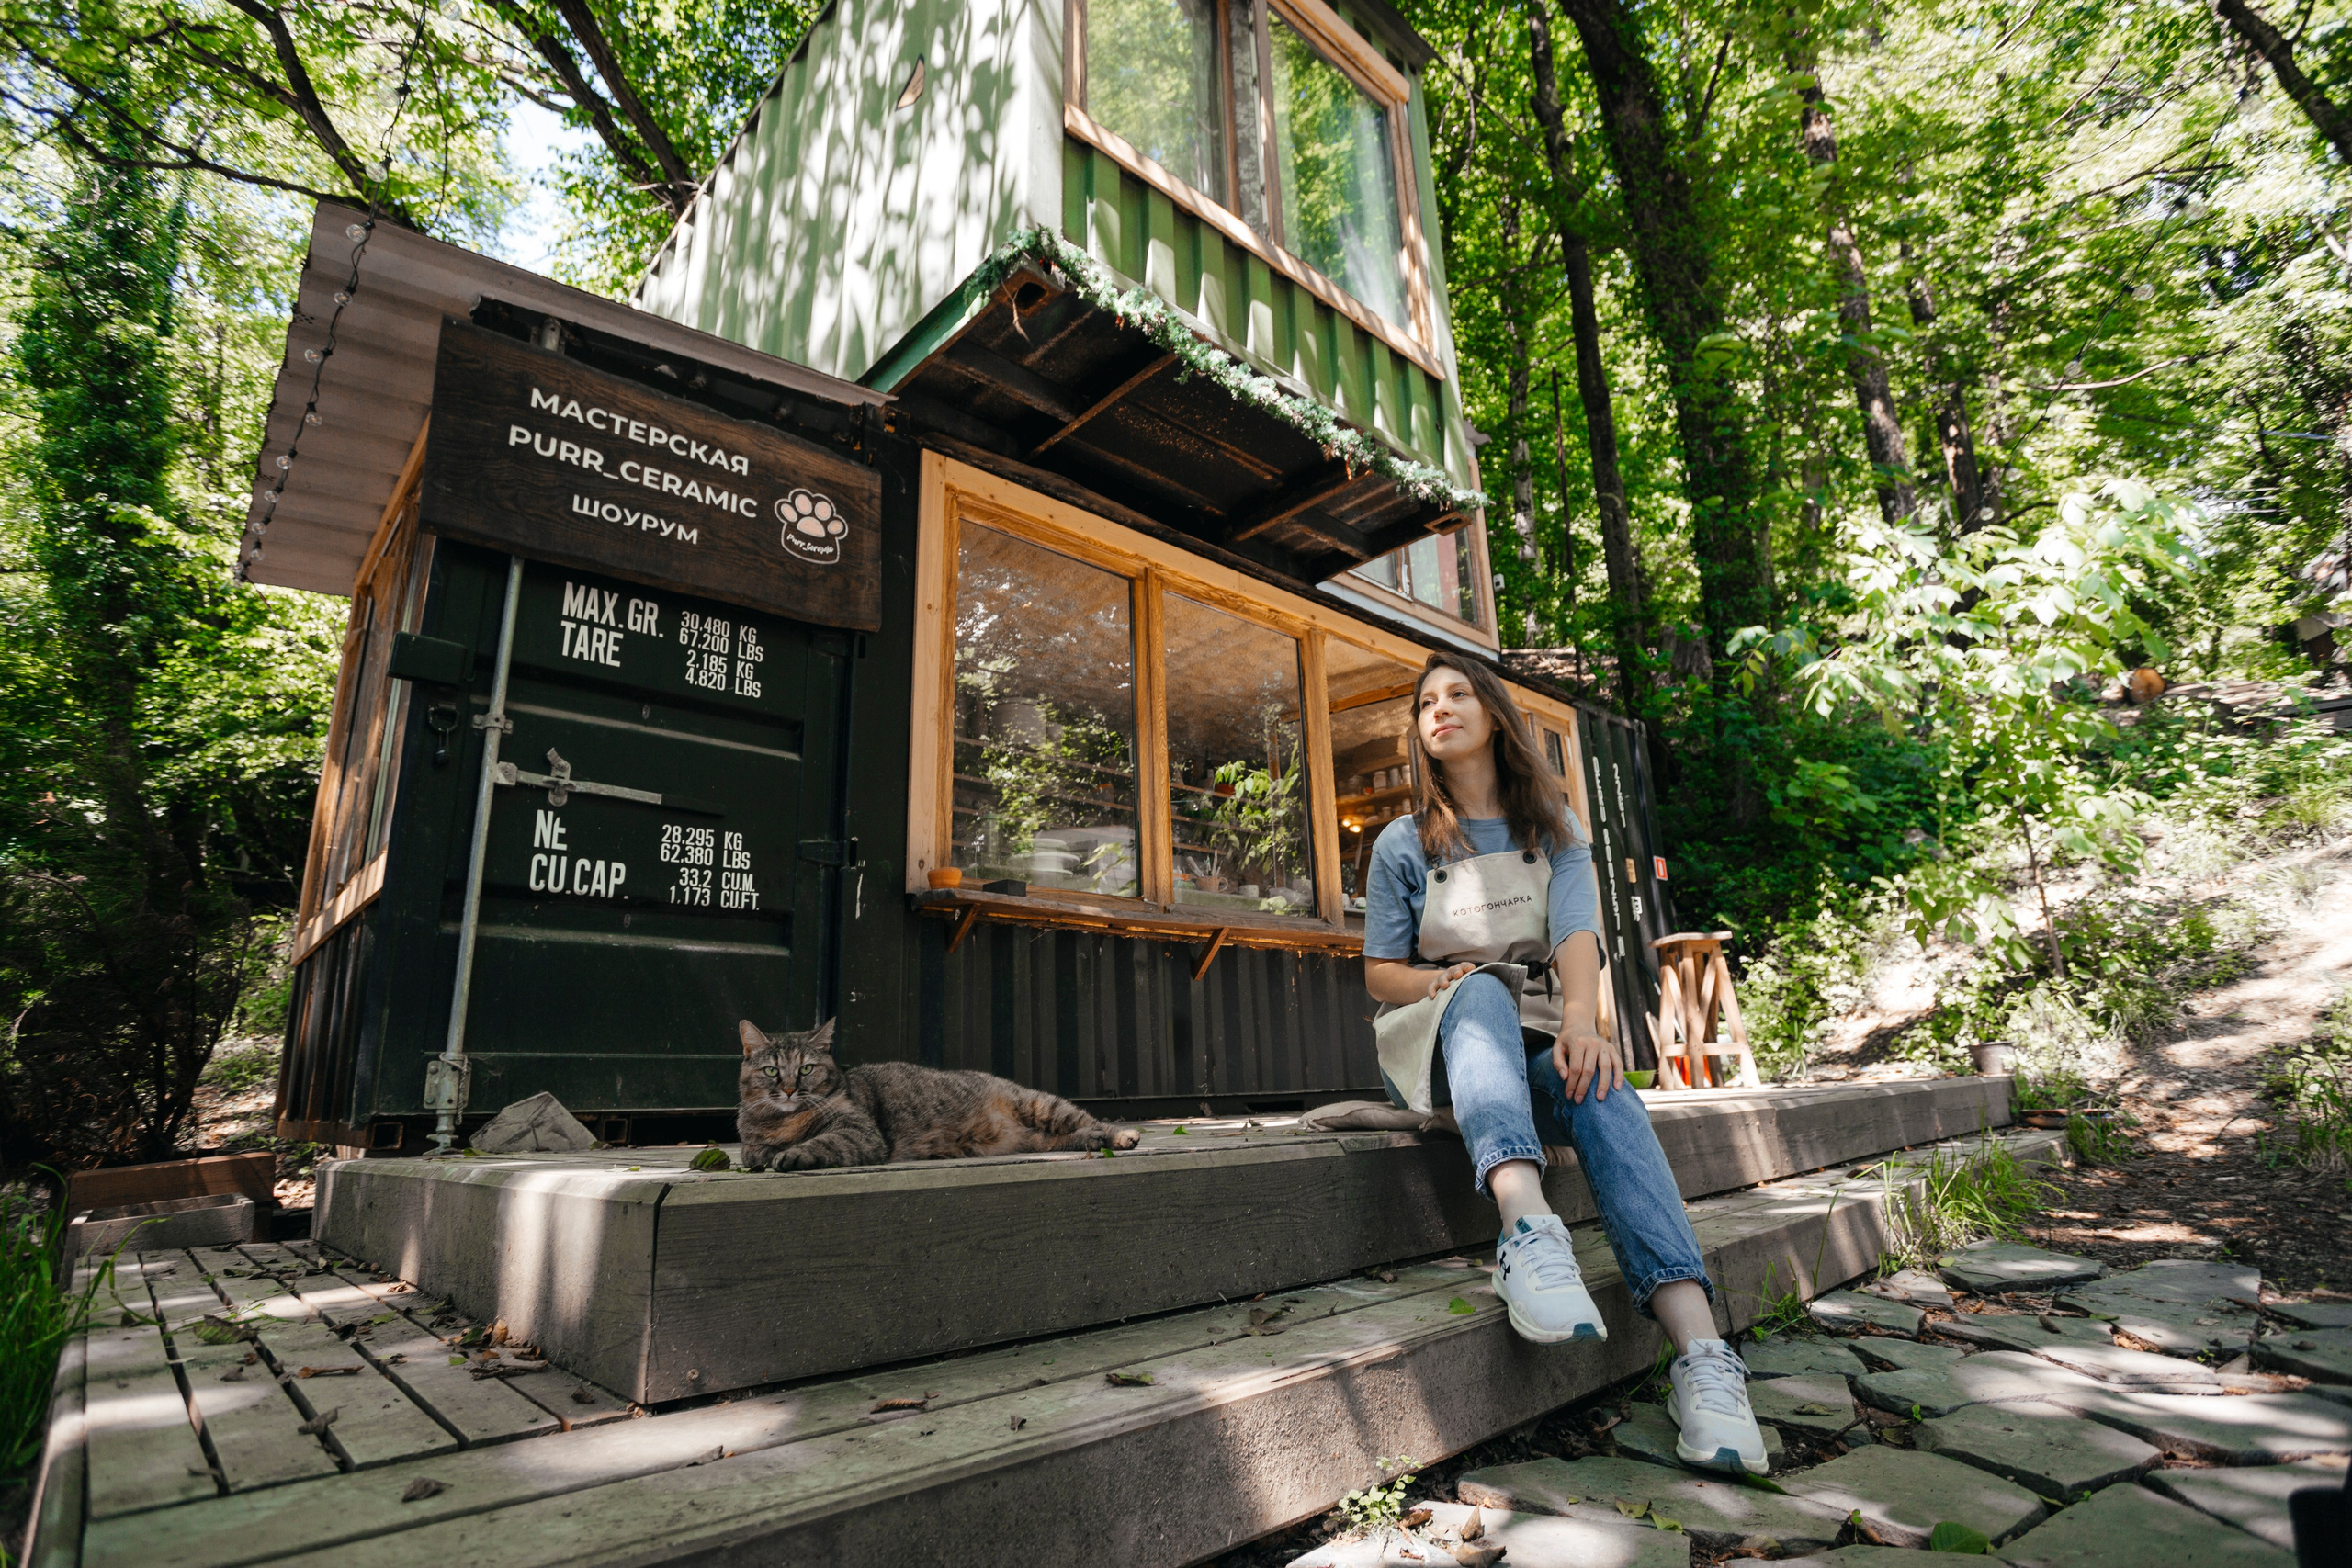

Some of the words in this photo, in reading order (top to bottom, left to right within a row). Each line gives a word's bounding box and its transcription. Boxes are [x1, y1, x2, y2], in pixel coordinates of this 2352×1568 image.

[530, 387, 750, 477] МАСТЕРСКАЯ
[508, 423, 759, 519] PURR_CERAMIC
[572, 493, 698, 546] ШОУРУМ
[560, 620, 625, 669] TARE
[739, 625, 758, 645] KG
[737, 640, 764, 663] LBS
[734, 660, 754, 681] KG
[734, 677, 762, 700] LBS
[723, 830, 743, 852] KG
[722, 850, 752, 871] LBS
[679, 866, 712, 889] 33.2
[1453, 894, 1533, 918] КОТОГОНЧАРКА
